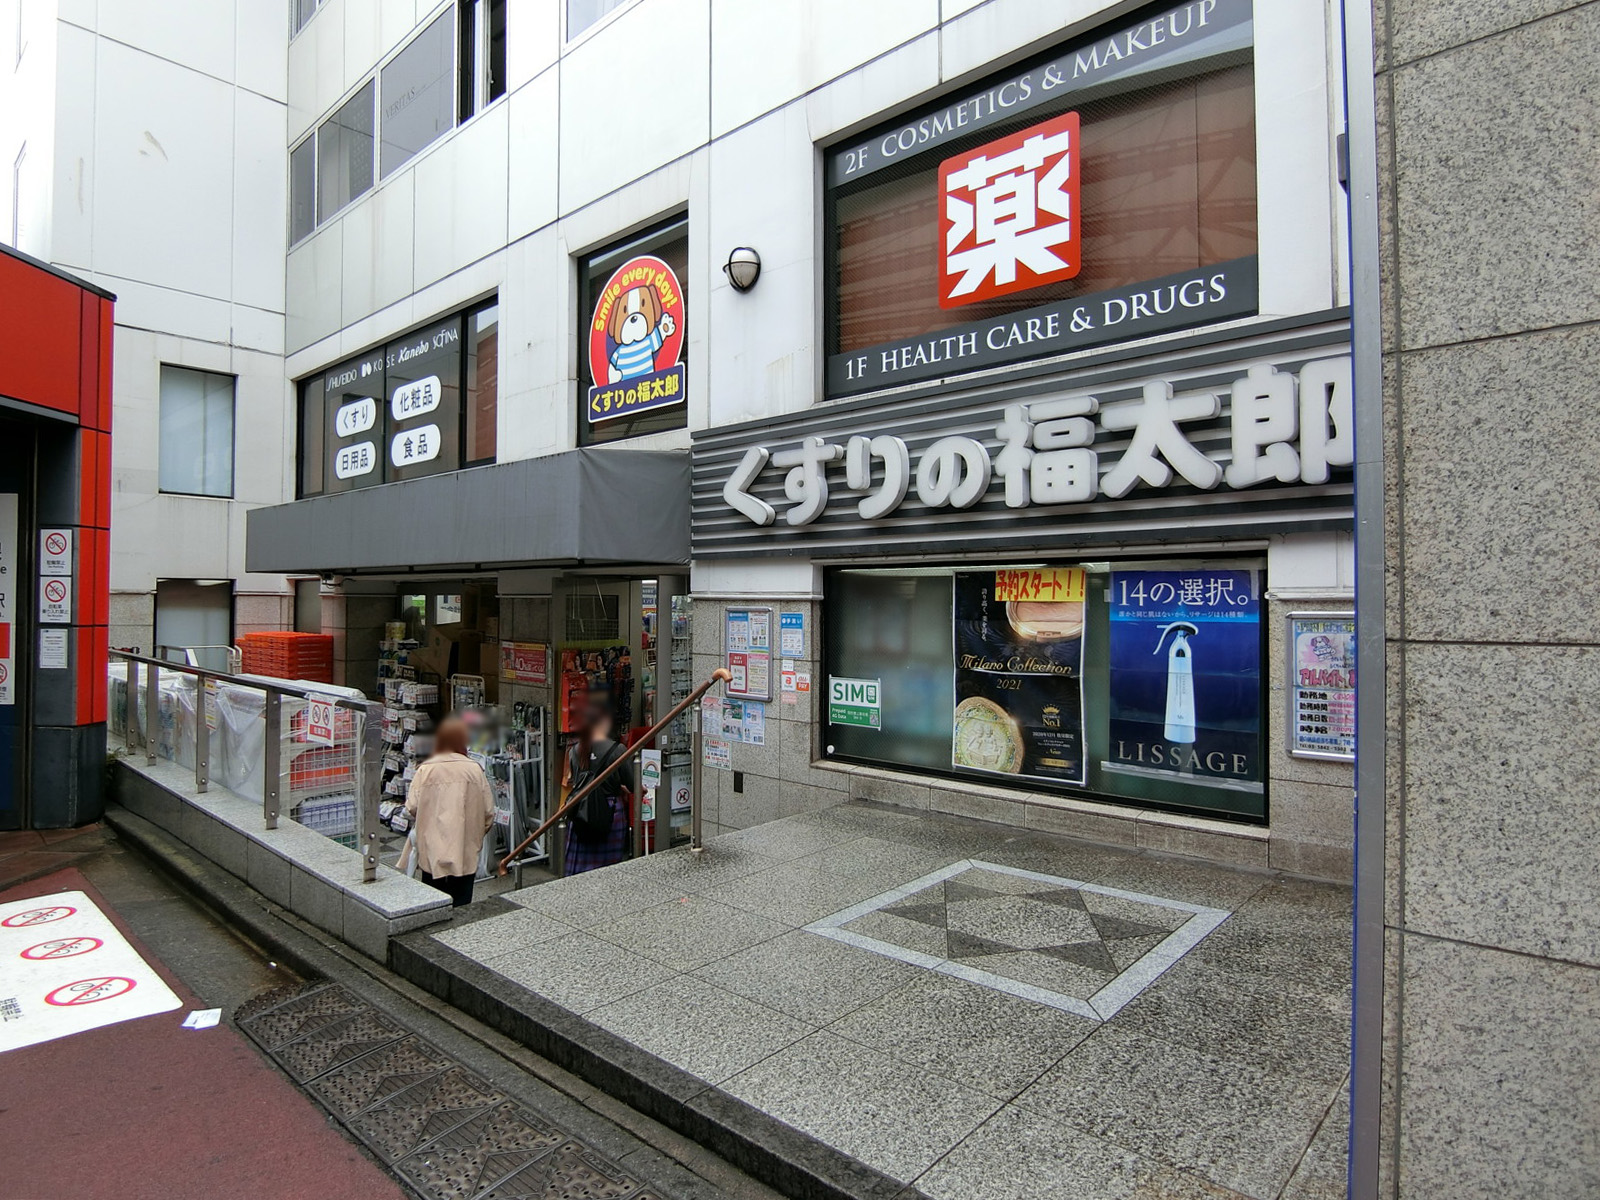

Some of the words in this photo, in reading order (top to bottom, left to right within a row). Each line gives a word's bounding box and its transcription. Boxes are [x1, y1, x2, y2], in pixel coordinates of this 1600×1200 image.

[845, 146, 868, 174] 2F
[881, 81, 1032, 157] COSMETICS
[1042, 65, 1064, 89] &
[1073, 1, 1217, 79] MAKEUP
[946, 130, 1070, 298] 薬
[621, 267, 656, 287] every
[655, 271, 678, 308] day!
[846, 356, 868, 380] 1F
[881, 331, 977, 373] HEALTH
[986, 313, 1060, 350] CARE
[1070, 306, 1095, 331] &
[1103, 273, 1227, 326] DRUGS
[326, 369, 358, 391] SHISEIDO
[398, 341, 430, 363] Kanebo
[400, 383, 433, 413] 化粧品
[591, 374, 680, 413] くすりの福太郎
[343, 404, 369, 430] くすり
[403, 433, 428, 459] 食品
[723, 357, 1354, 526] くすりの福太郎
[342, 447, 369, 471] 日用品
[1118, 578, 1249, 606] 14の選択。
[960, 653, 1004, 670] Milano
[1007, 656, 1072, 674] Collection
[833, 682, 864, 703] SIM
[996, 678, 1022, 690] 2021
[1042, 718, 1061, 727] No.1
[1117, 740, 1248, 775] LISSAGE
